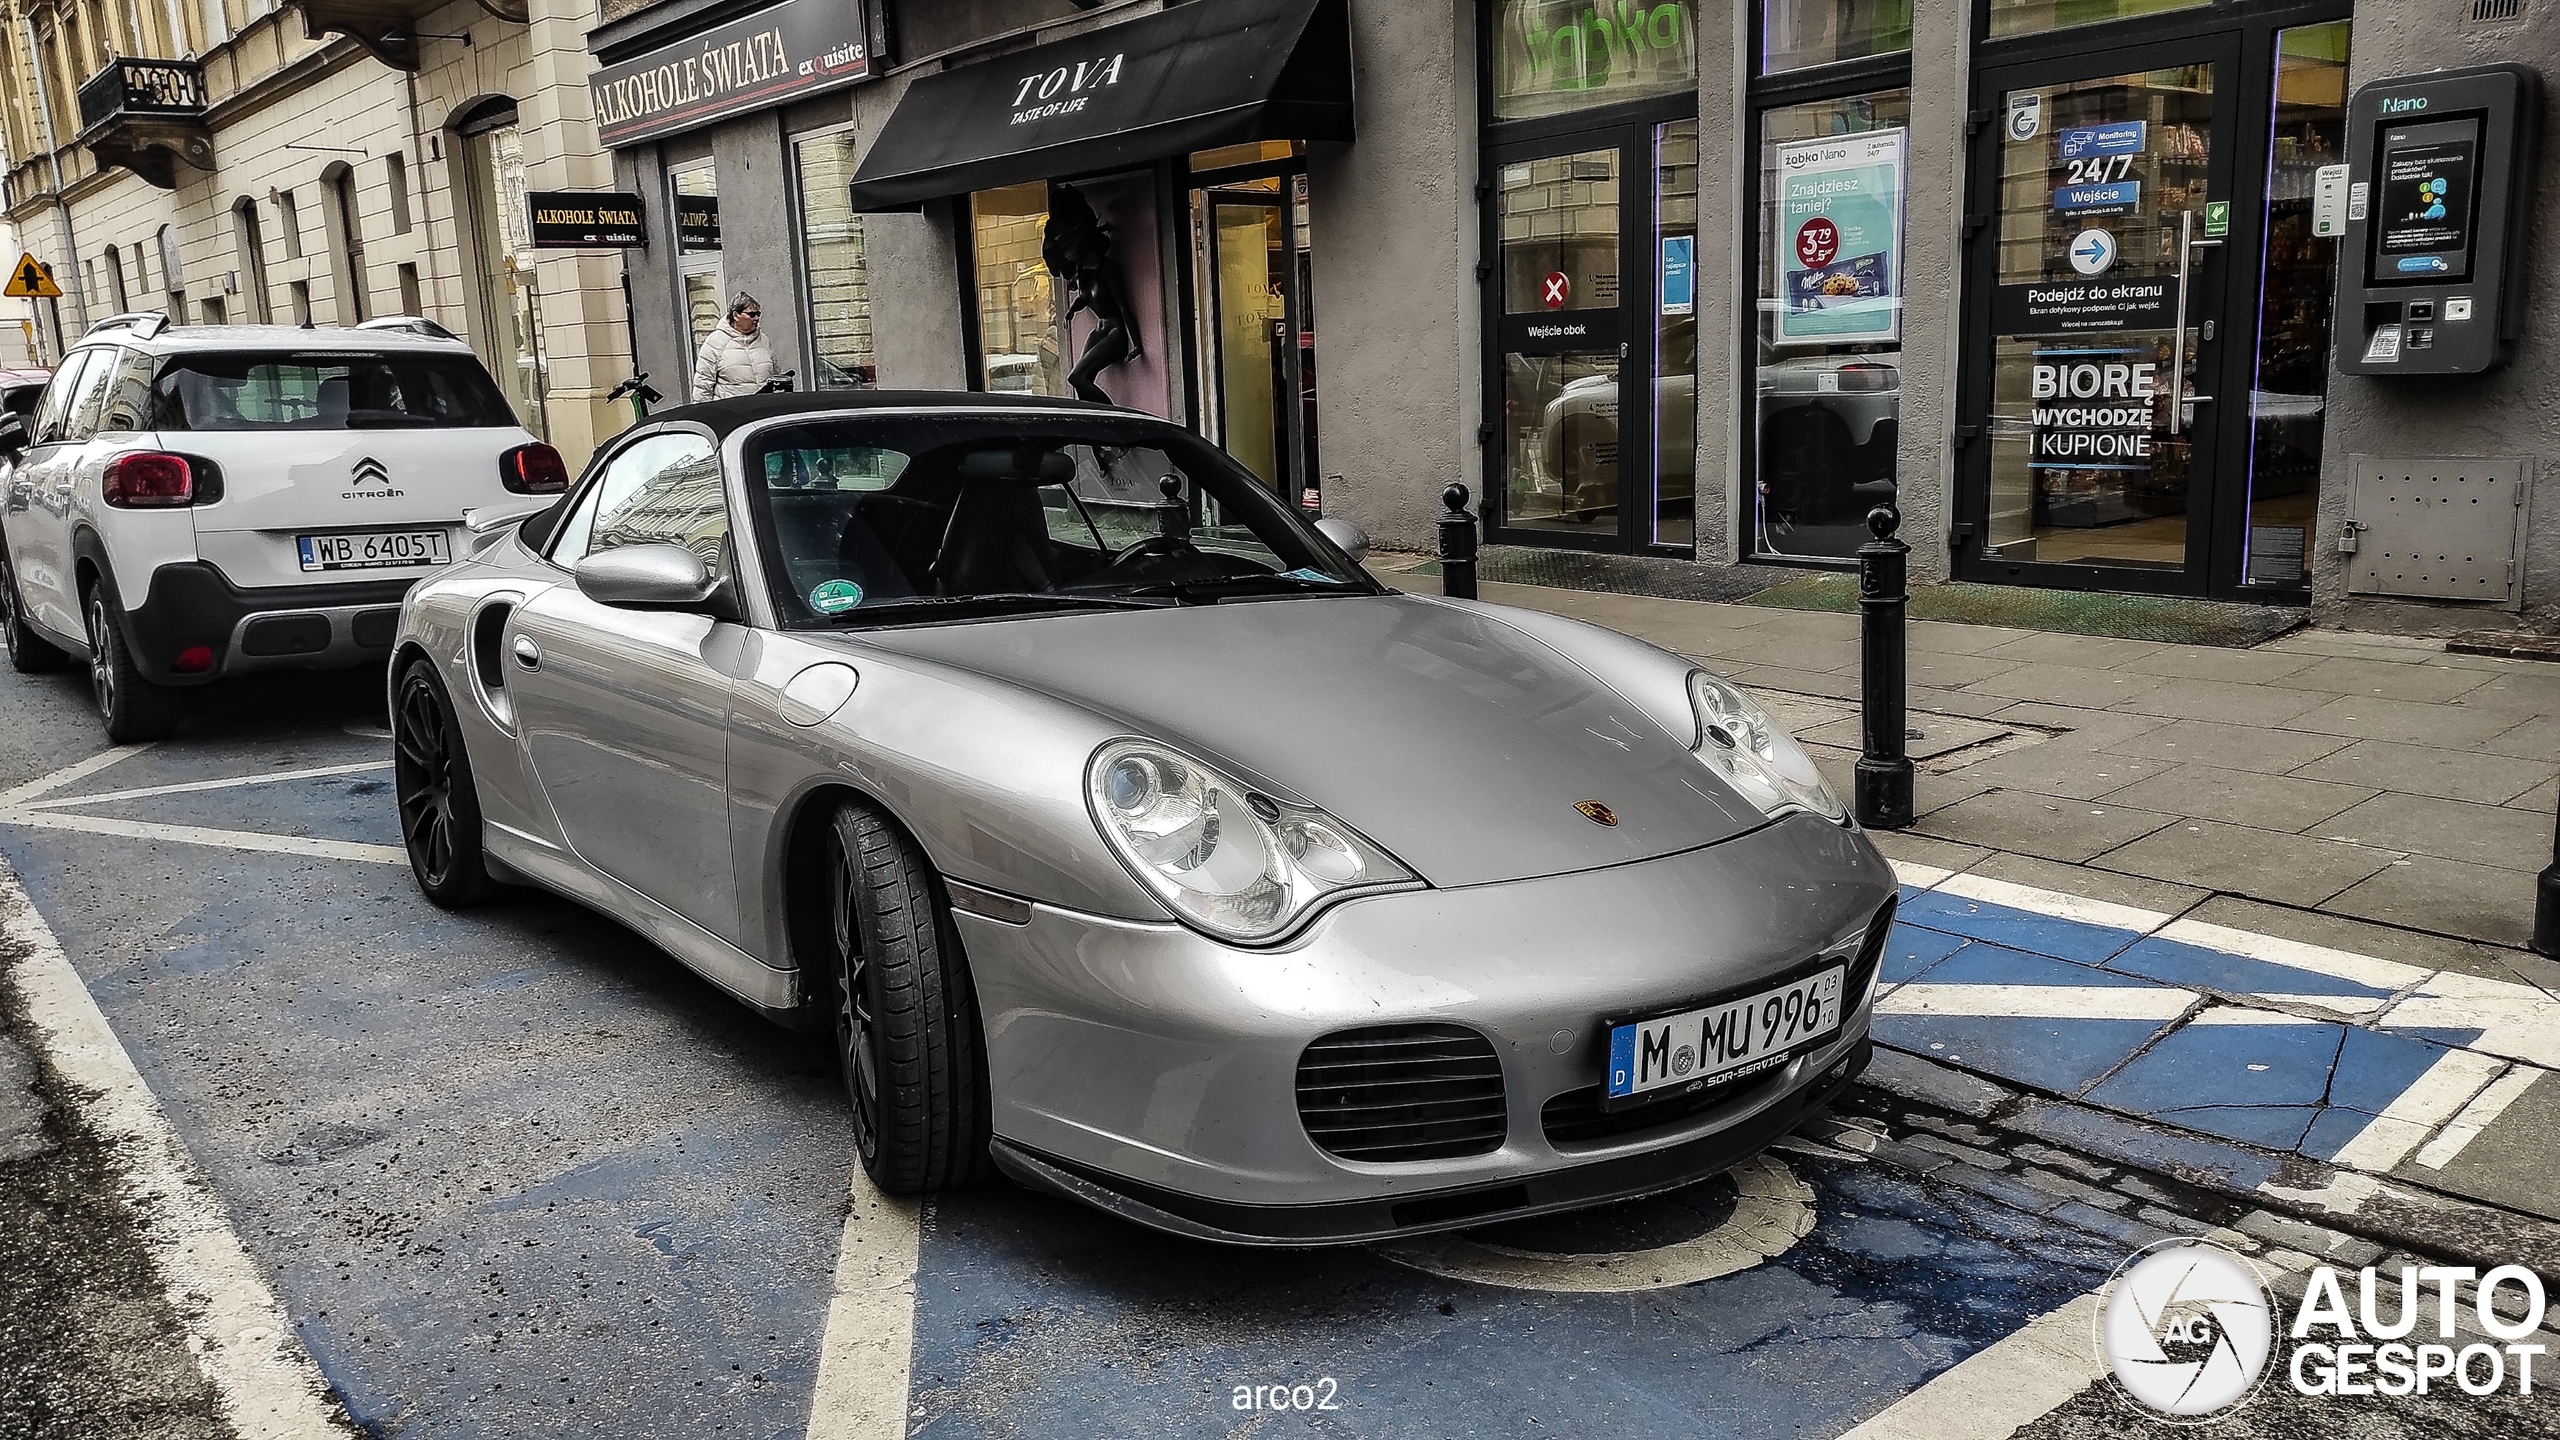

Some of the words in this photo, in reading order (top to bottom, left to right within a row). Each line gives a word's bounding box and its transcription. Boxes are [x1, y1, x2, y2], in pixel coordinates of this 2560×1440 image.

[595, 57, 700, 127] ALKOHOLE
[702, 26, 789, 98] ŚWIATA
[1012, 53, 1124, 107] TOVA
[1010, 106, 1044, 125] TASTE
[1042, 101, 1062, 116] OF
[1060, 96, 1089, 114] LIFE
[2382, 97, 2428, 113] Nano
[2098, 130, 2137, 140] Monitoring
[1785, 152, 1819, 166] żabka
[1820, 149, 1847, 160] Nano
[2067, 154, 2134, 184] 24/7
[1791, 179, 1859, 198] Znajdziesz
[2070, 188, 2119, 203] Wejście
[1791, 197, 1832, 214] taniej?
[536, 208, 595, 225] ALKOHOLE
[598, 206, 638, 225] ŚWIATA
[2028, 286, 2085, 304] Podejdź
[2088, 286, 2107, 299] do
[2111, 284, 2163, 299] ekranu
[2029, 307, 2048, 315] Ekran
[2049, 305, 2081, 314] dotykowy
[2082, 303, 2117, 313] podpowie
[2125, 302, 2137, 311] jak
[2138, 301, 2160, 310] wejść
[1528, 324, 1562, 340] Wejście
[1563, 324, 1587, 336] obok
[2032, 362, 2156, 406] BIORĘ
[2031, 408, 2153, 430] WYCHODZĘ
[2028, 433, 2034, 455] I
[2042, 433, 2152, 456] KUPIONE
[318, 538, 353, 561] WB
[364, 533, 441, 559] 6405T
[829, 584, 842, 597] 4
[1821, 1009, 1834, 1026] 10
[1640, 1024, 1671, 1083] M
[1699, 1004, 1754, 1070] MU
[1761, 981, 1822, 1050] 996
[1615, 1070, 1626, 1086] D
[1706, 1051, 1789, 1087] SOR-SERVICE
